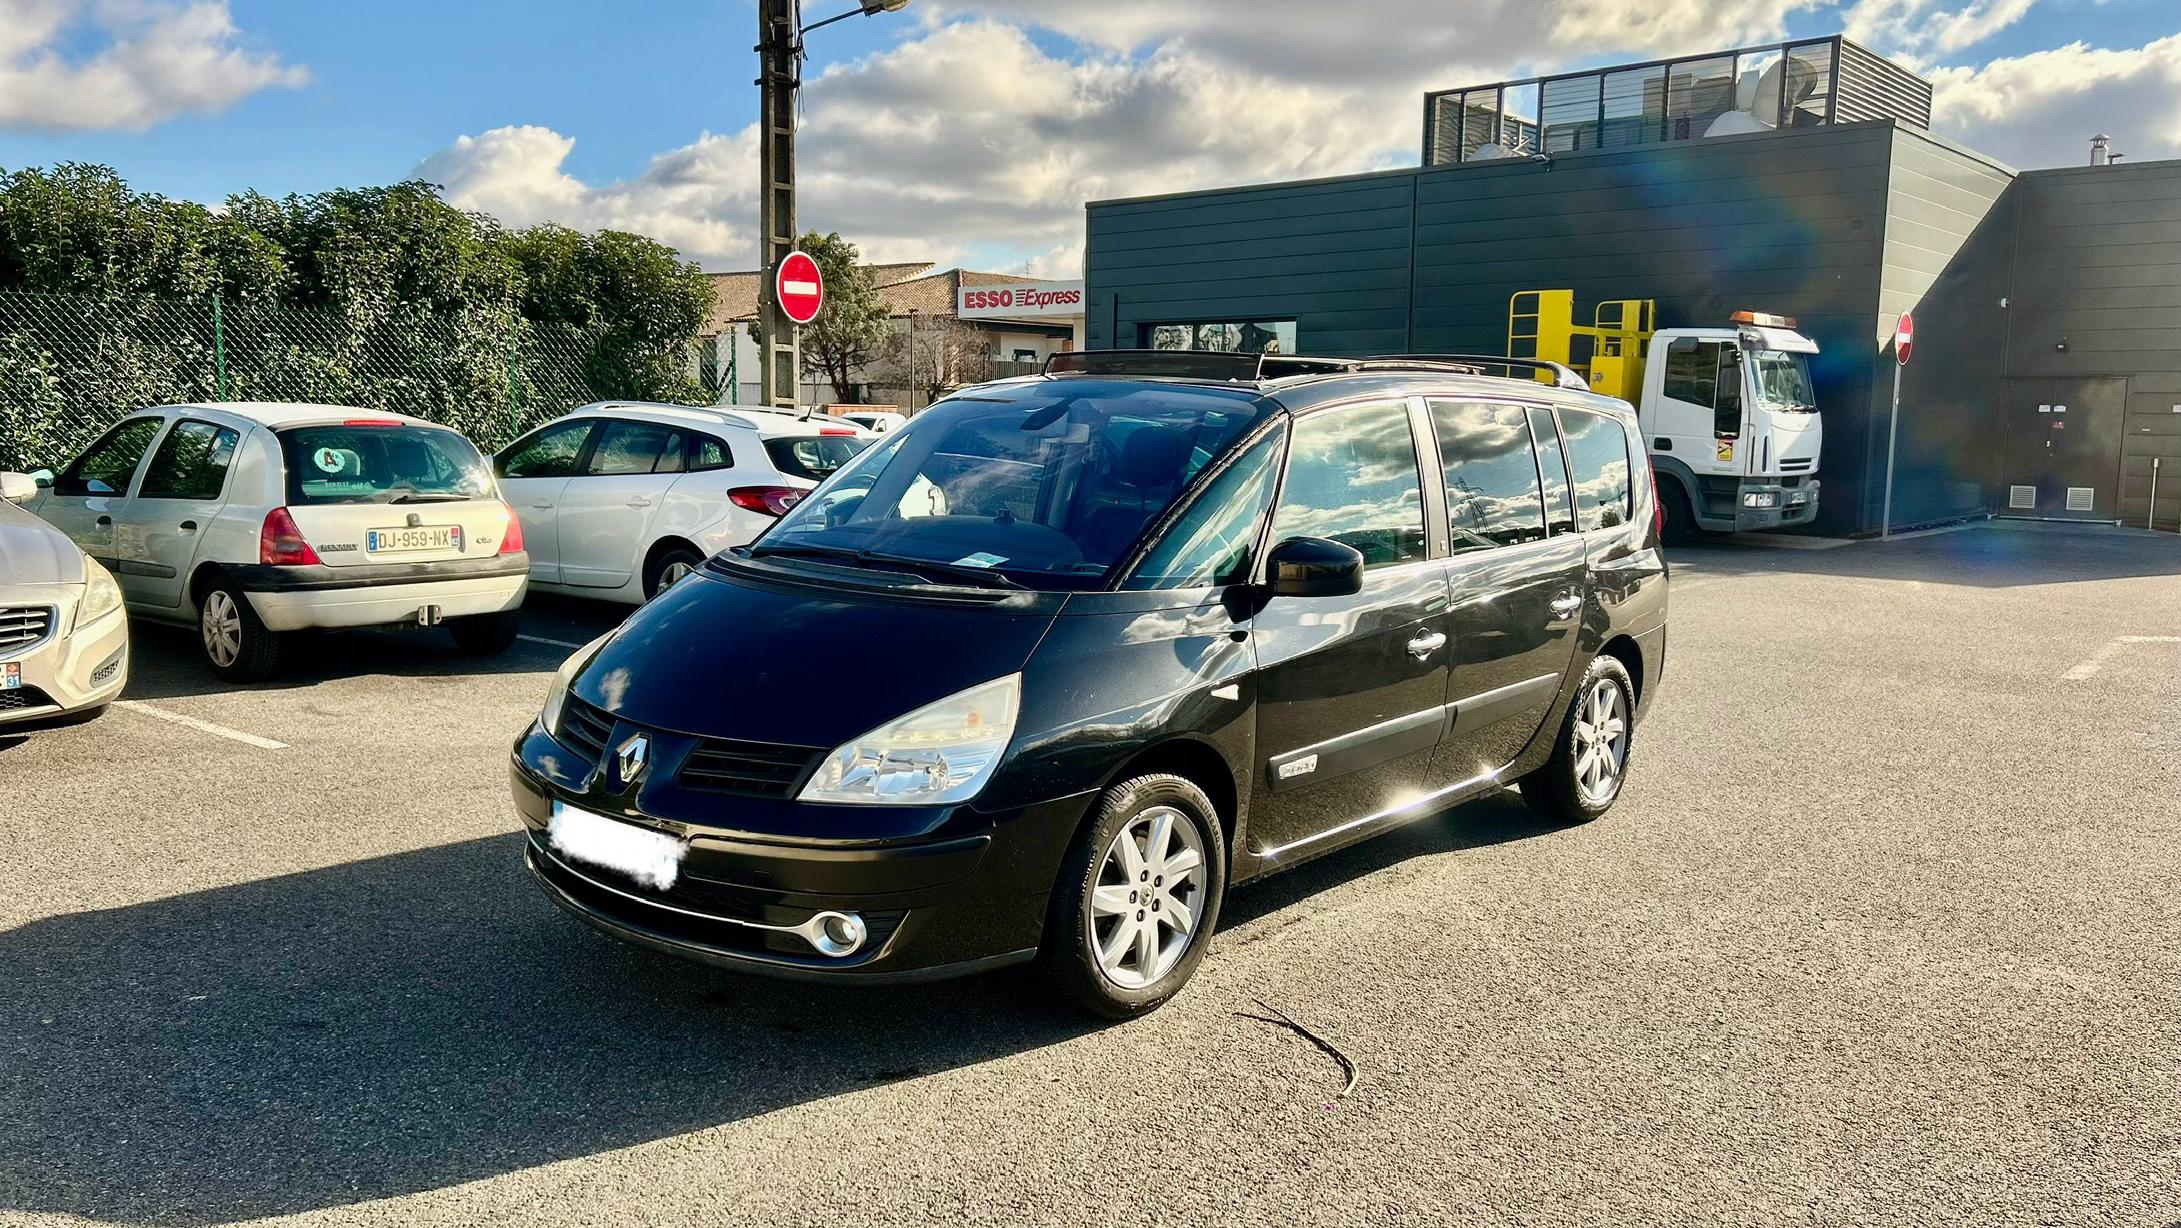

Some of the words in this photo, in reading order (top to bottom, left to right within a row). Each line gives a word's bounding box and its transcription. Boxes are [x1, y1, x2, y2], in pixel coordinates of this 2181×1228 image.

[964, 289, 1013, 309] ESSO
[1024, 288, 1081, 309] Express
[378, 530, 449, 549] DJ-959-NX
[7, 676, 20, 687] 31
